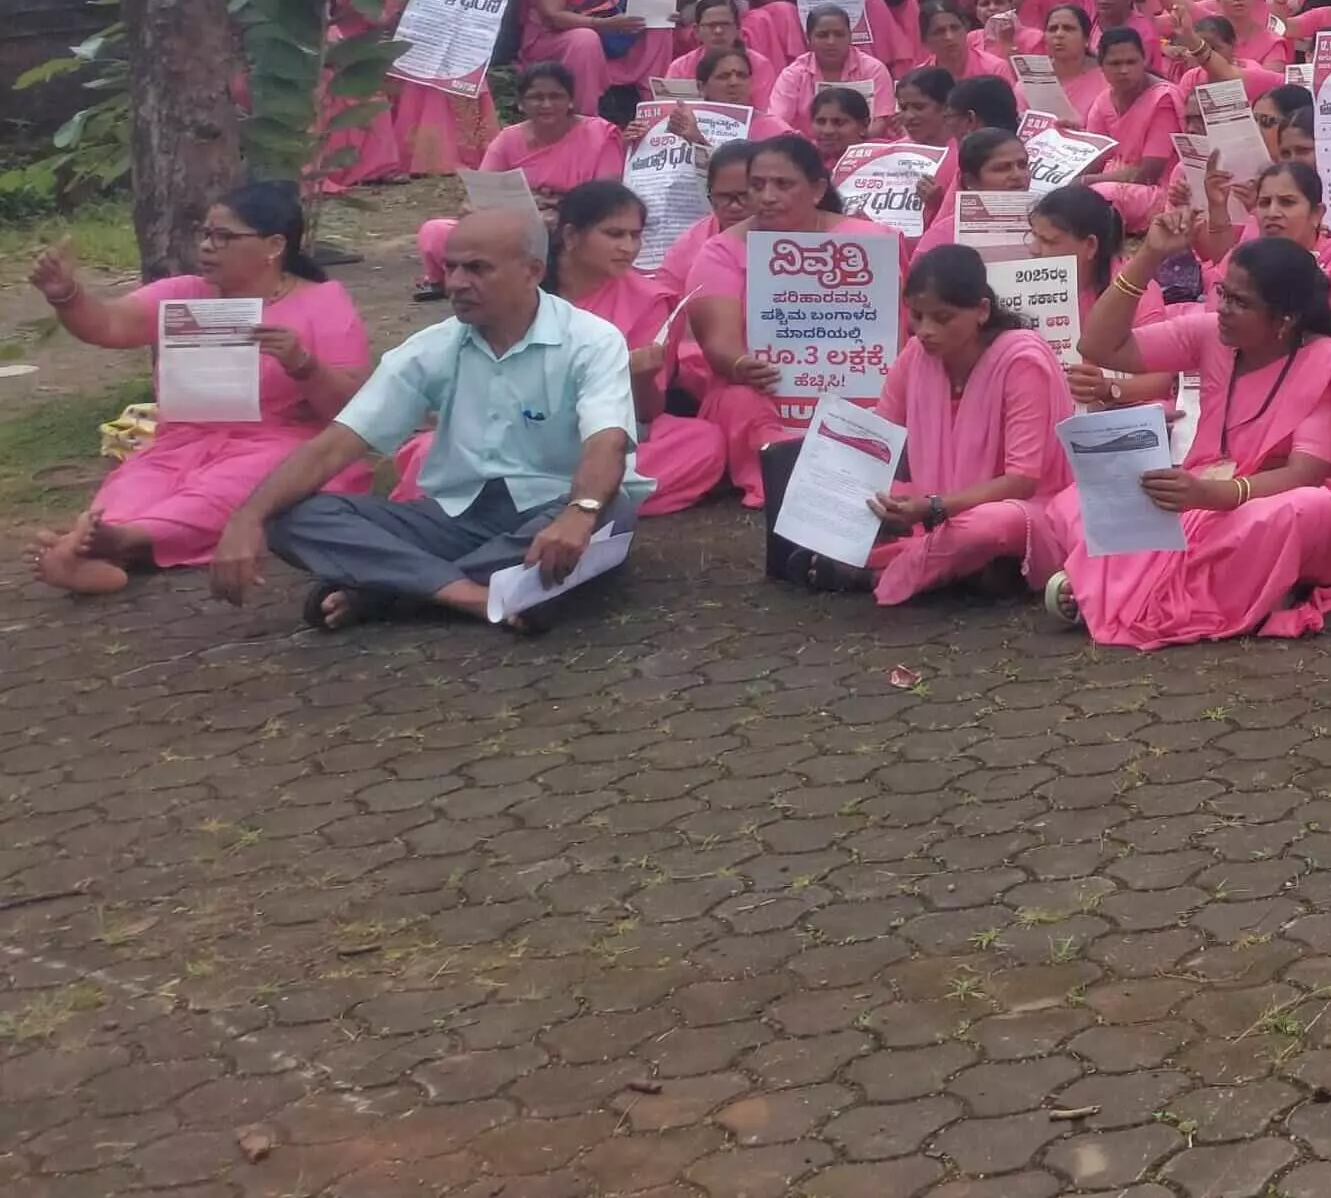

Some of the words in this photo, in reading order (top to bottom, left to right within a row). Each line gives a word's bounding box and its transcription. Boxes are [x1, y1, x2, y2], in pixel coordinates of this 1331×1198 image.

[855, 177, 884, 189] ಆಶಾ
[770, 239, 874, 288] ನಿವೃತ್ತಿ
[1015, 267, 1068, 283] 2025ರಲ್ಲಿ
[772, 289, 871, 309] ಪರಿಹಾರವನ್ನು
[1028, 290, 1068, 306] ಸರ್ಕಾರ
[761, 308, 807, 323] ಪಶ್ಚಿಮ
[811, 306, 877, 322] ಬಂಗಾಳದ
[776, 325, 864, 345] ಮಾದರಿಯಲ್ಲಿ
[827, 344, 888, 376] ಲಕ್ಷಕ್ಕೆ
